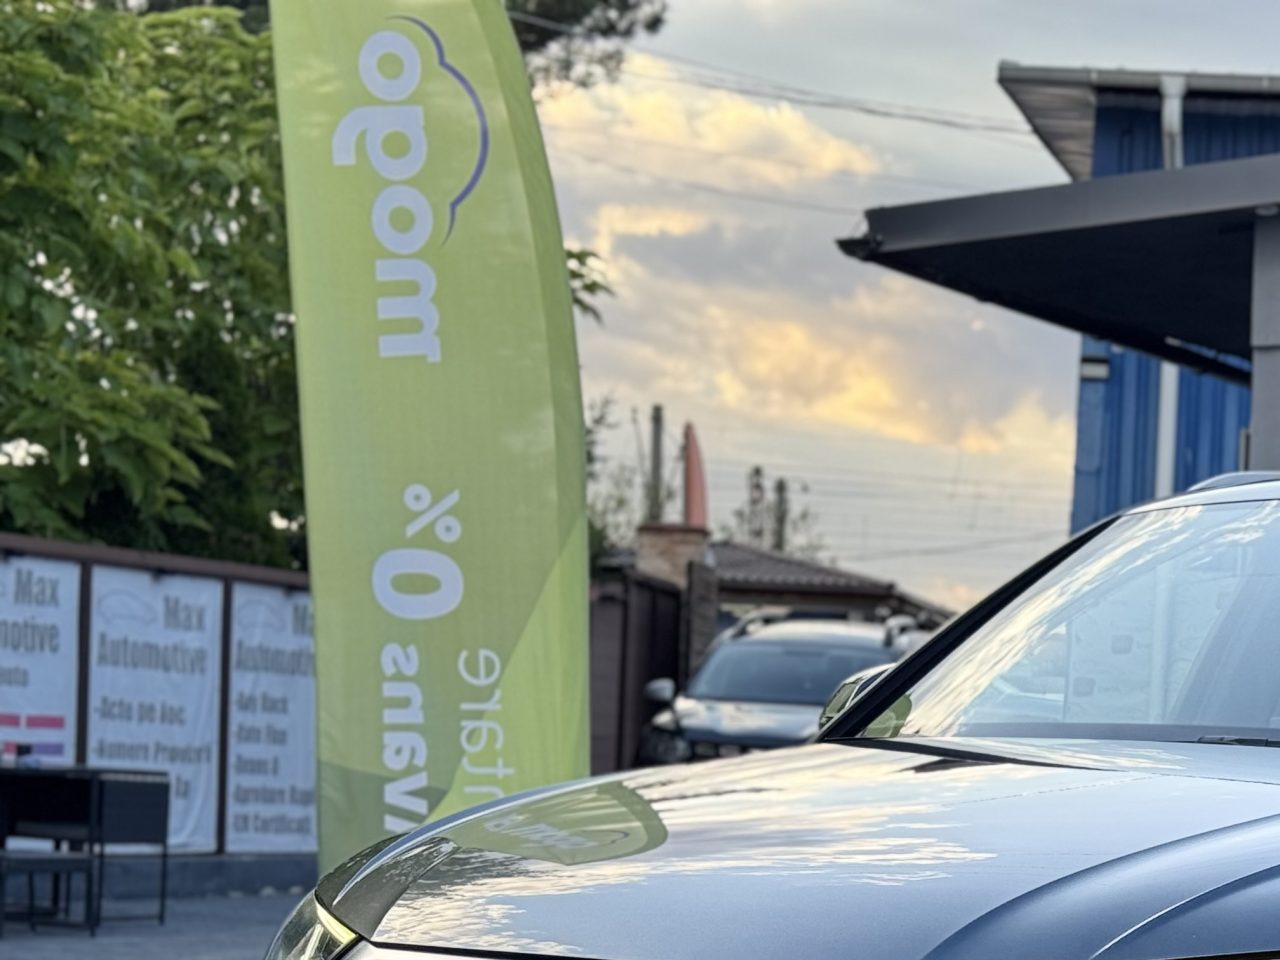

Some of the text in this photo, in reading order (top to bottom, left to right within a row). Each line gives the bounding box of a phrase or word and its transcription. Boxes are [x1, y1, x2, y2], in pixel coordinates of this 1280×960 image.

[14, 567, 60, 608] Max
[163, 595, 207, 632] Max
[97, 632, 209, 676] Automotive
